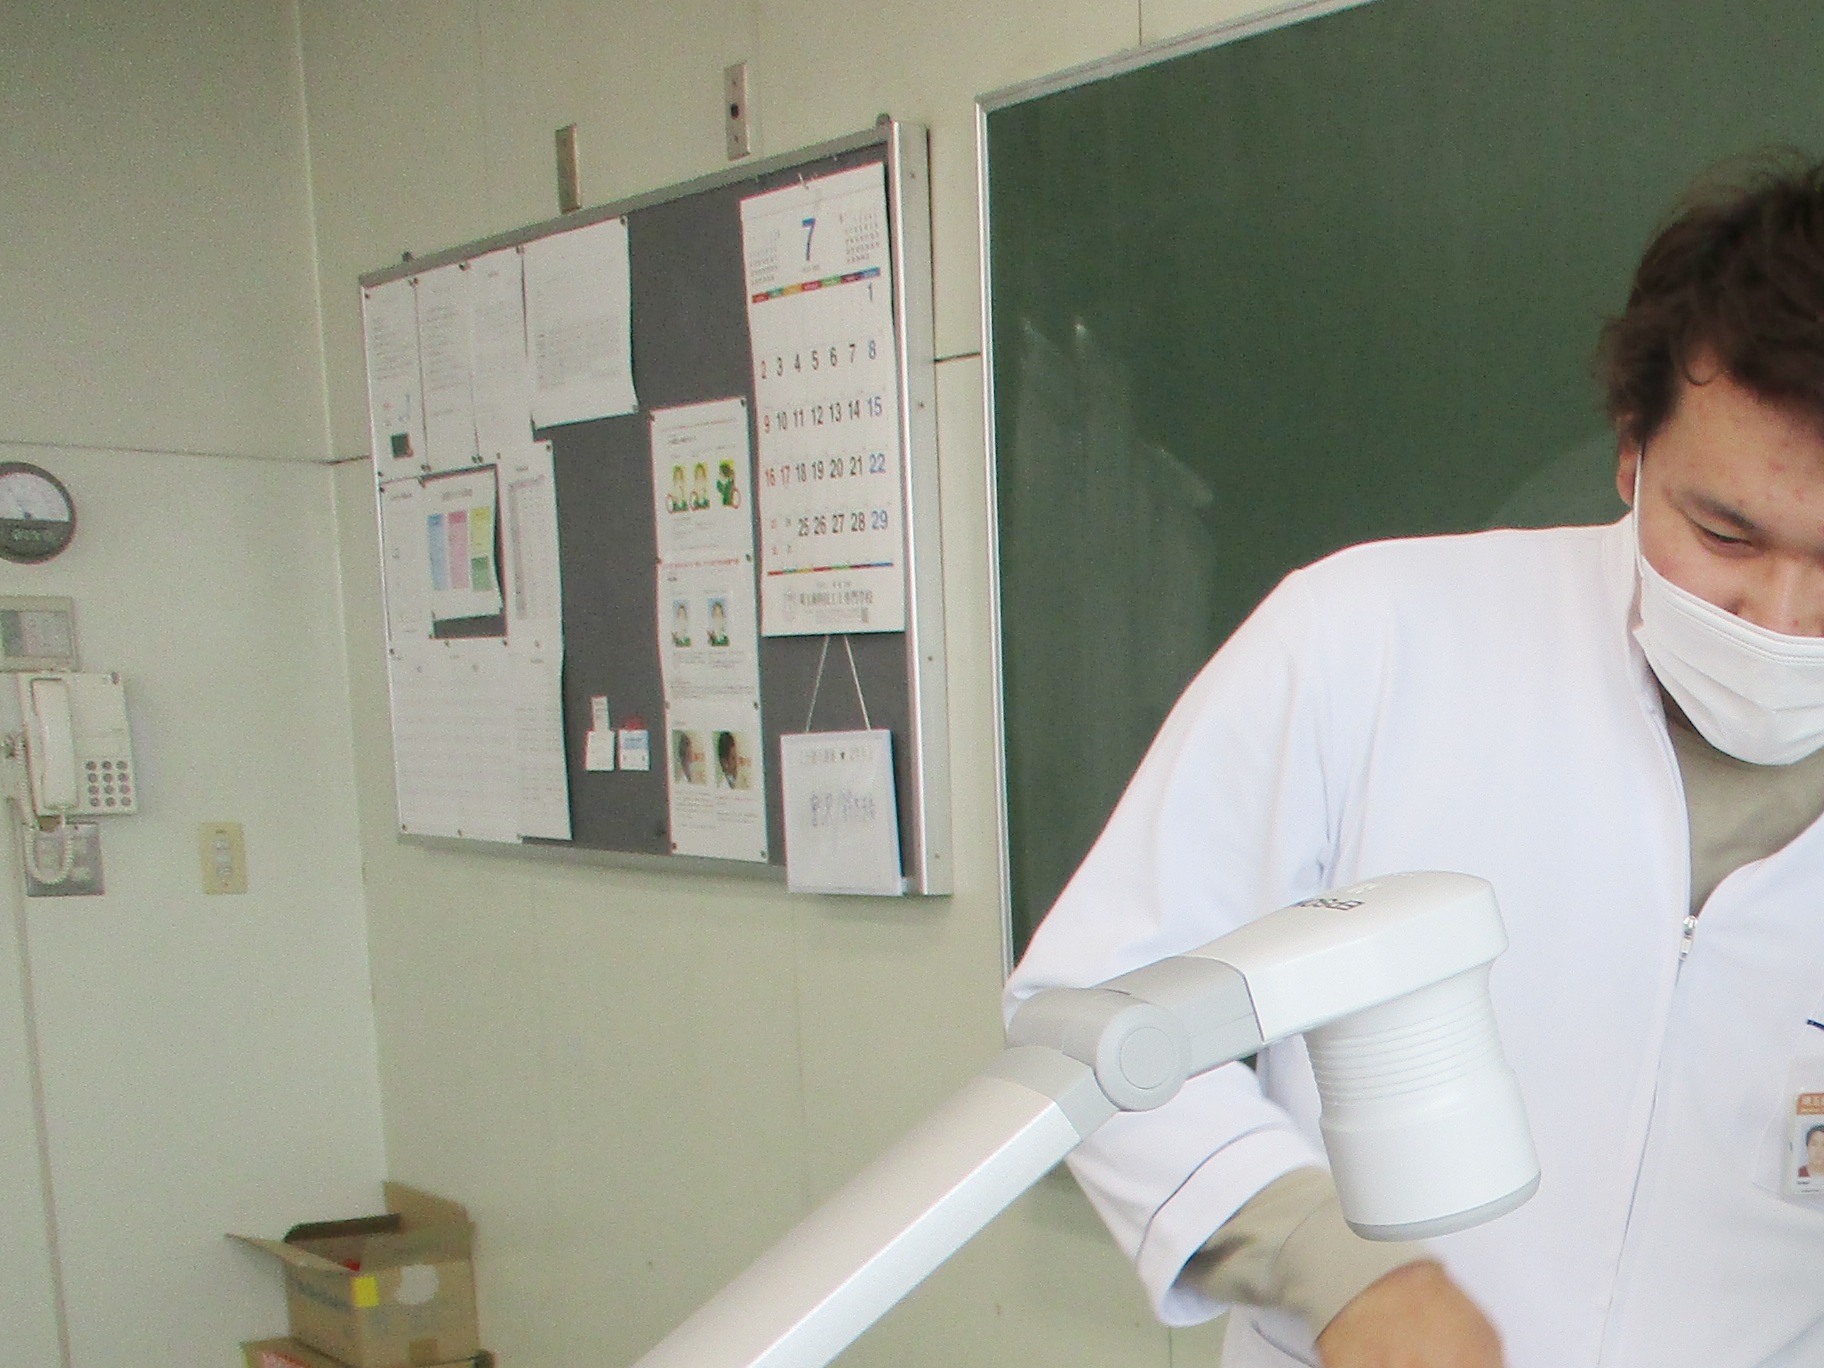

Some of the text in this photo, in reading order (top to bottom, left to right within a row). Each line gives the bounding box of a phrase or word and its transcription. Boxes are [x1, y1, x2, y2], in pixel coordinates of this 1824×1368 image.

[802, 217, 816, 261] 7
[761, 340, 876, 379] 2 3 4 5 6 7 8
[764, 396, 883, 434] 9 10 11 12 13 14 15
[765, 453, 886, 487] 16 17 18 19 20 21 22
[798, 517, 809, 537] 25
[814, 515, 827, 535] 26
[832, 514, 845, 533] 27
[851, 512, 865, 532] 28
[871, 510, 888, 530] 29
